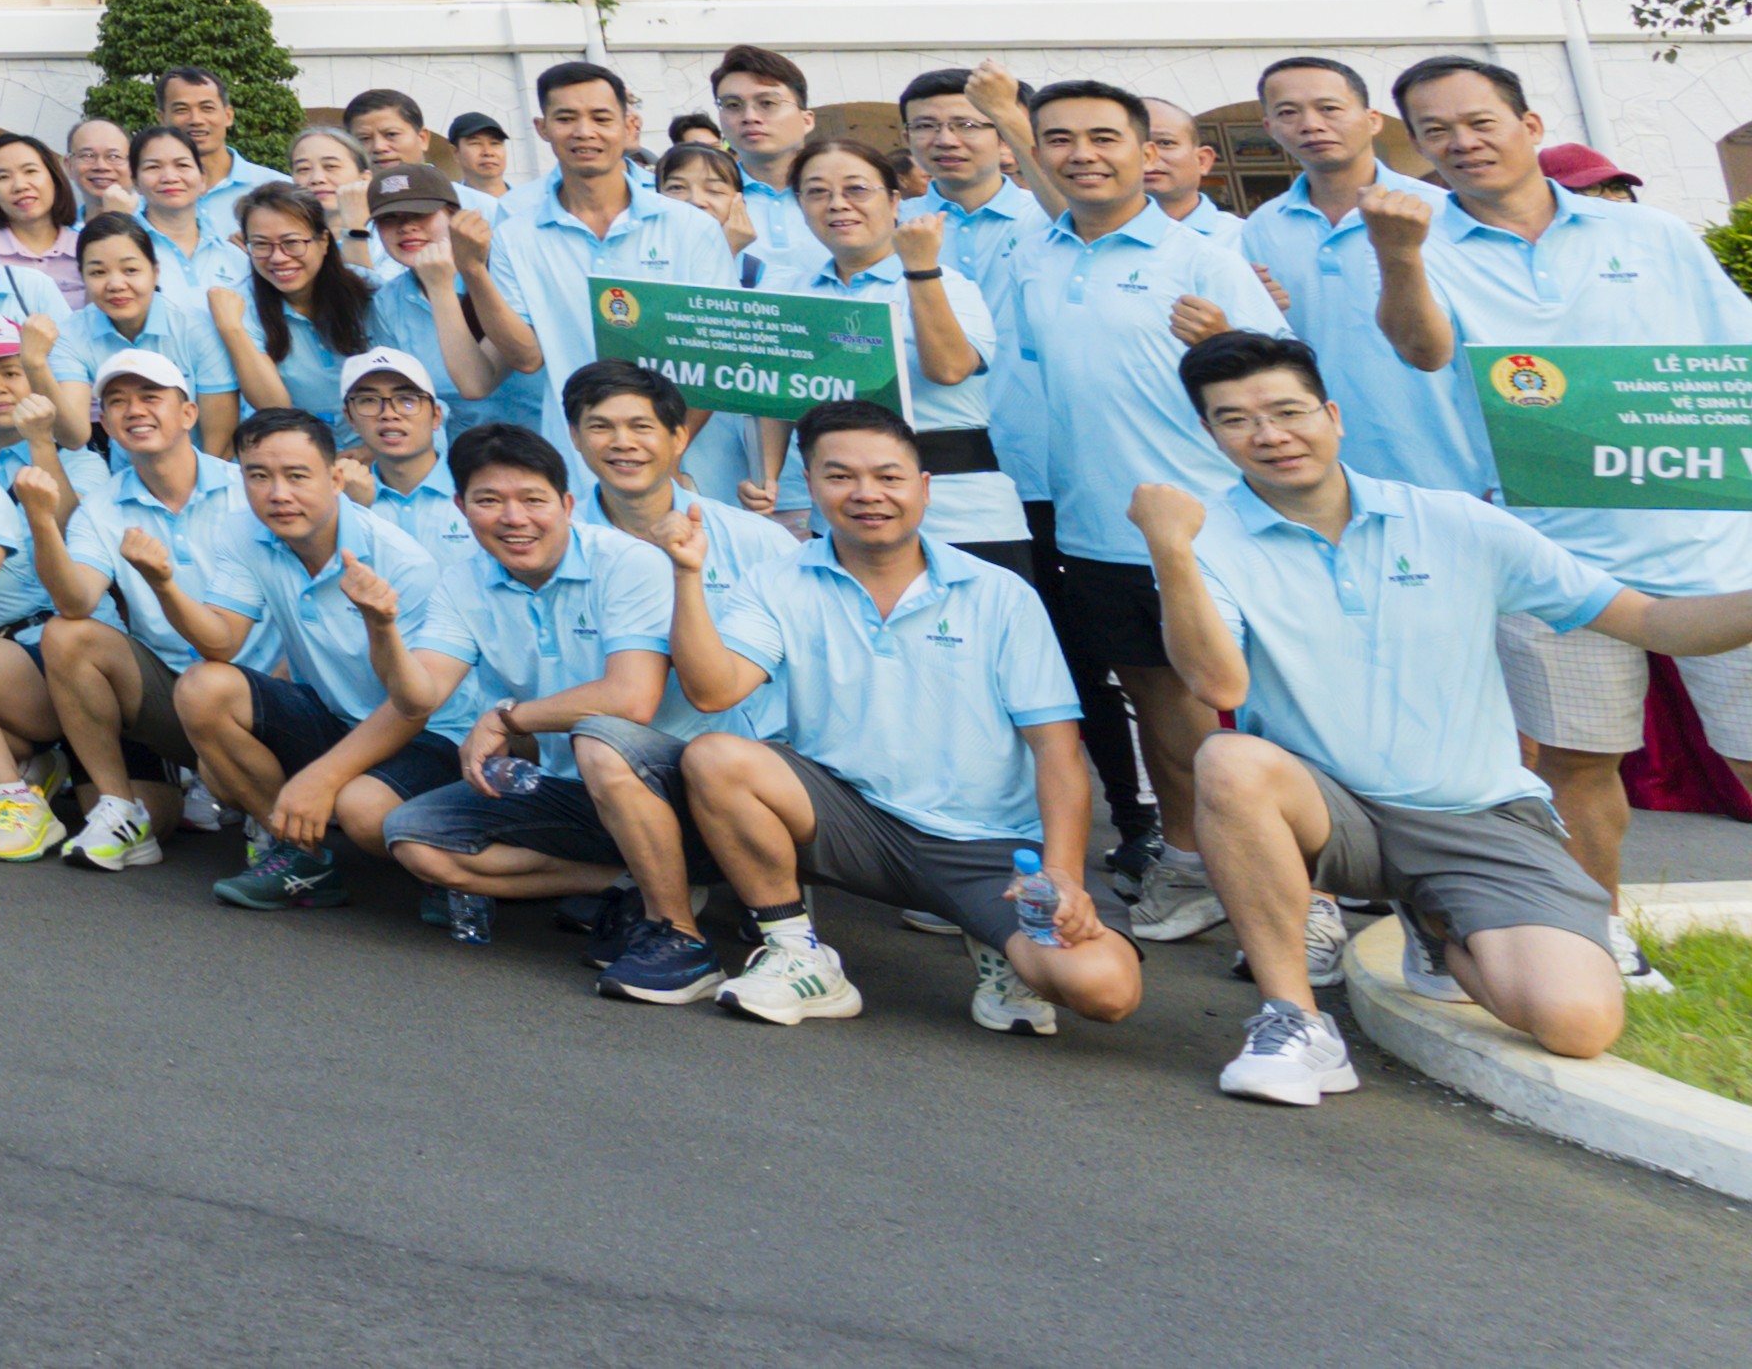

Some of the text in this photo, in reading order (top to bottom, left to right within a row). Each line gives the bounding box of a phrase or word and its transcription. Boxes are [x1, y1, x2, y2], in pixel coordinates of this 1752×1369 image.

[1685, 354, 1750, 372] PHÁT
[714, 362, 780, 395] CÔN
[789, 373, 855, 401] SƠN
[1696, 397, 1739, 409] SINH
[1594, 445, 1723, 485] DỊCH
